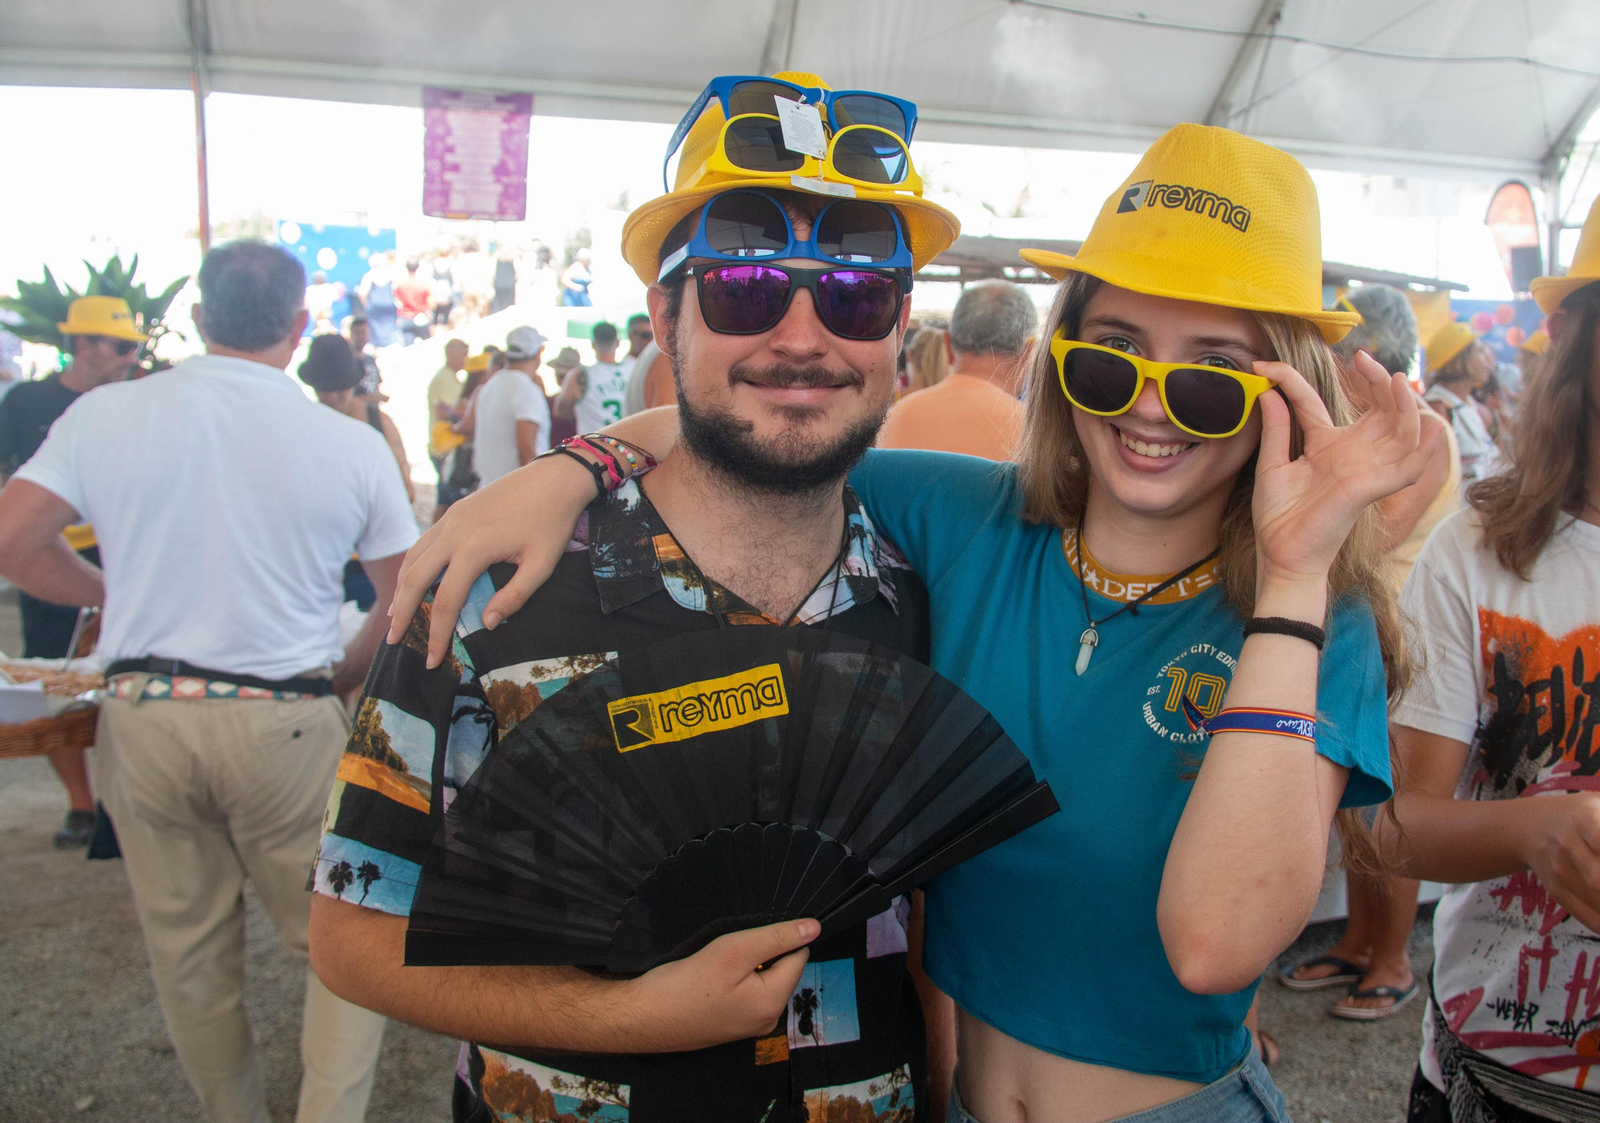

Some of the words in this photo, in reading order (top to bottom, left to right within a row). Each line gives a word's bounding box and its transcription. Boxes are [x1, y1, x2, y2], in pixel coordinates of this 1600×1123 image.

[1147, 184, 1251, 233] reyma
[1156, 651, 1188, 678] TOKYO
[1190, 643, 1217, 657] CITY
[659, 675, 784, 733] reyma
[1147, 684, 1161, 696] EST.
[1164, 667, 1226, 719] 10
[1142, 701, 1169, 738] URBAN
[1169, 731, 1210, 745] CLOT
